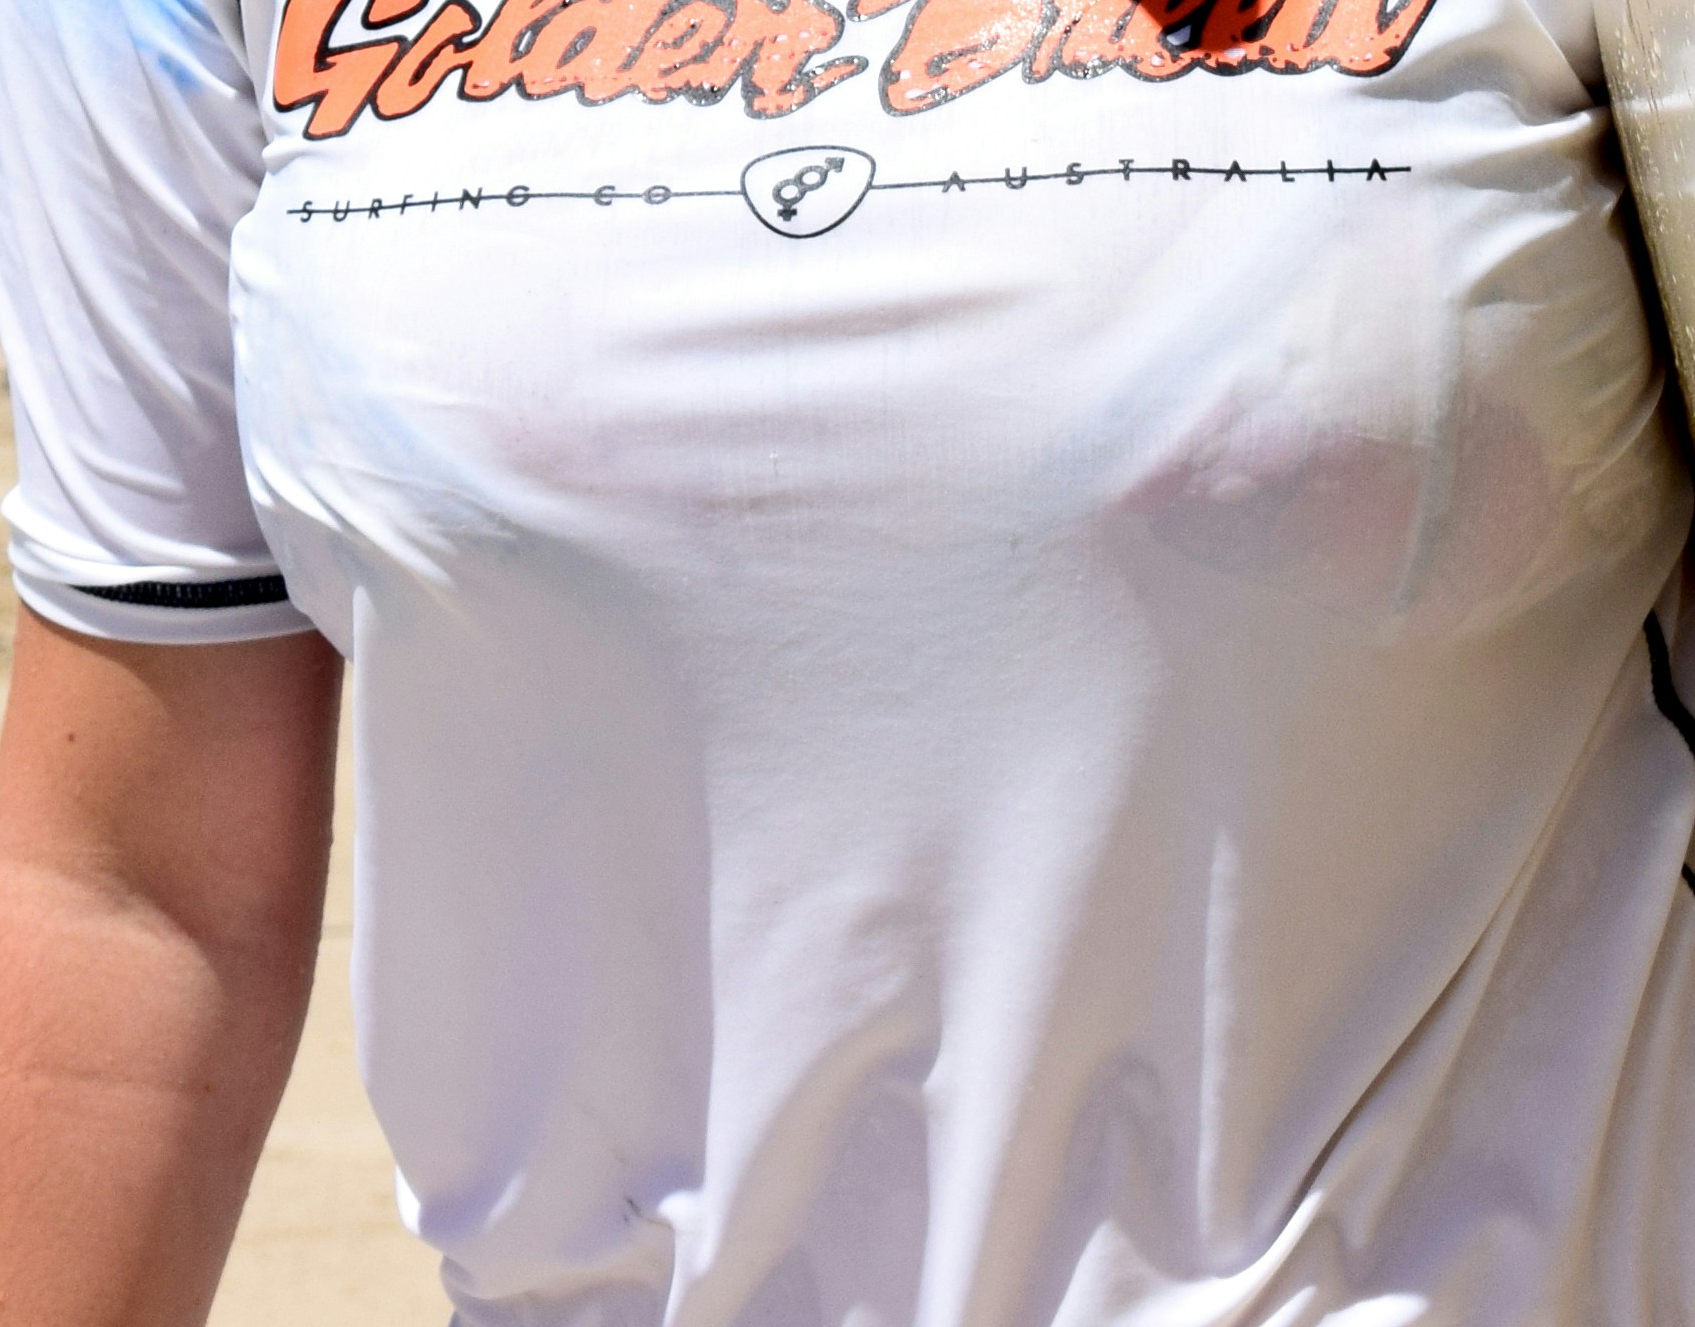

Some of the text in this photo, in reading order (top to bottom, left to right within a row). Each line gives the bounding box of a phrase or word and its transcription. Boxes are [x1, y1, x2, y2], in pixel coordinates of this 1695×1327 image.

[299, 158, 1388, 223] SURFING CO AUSTRALIA
